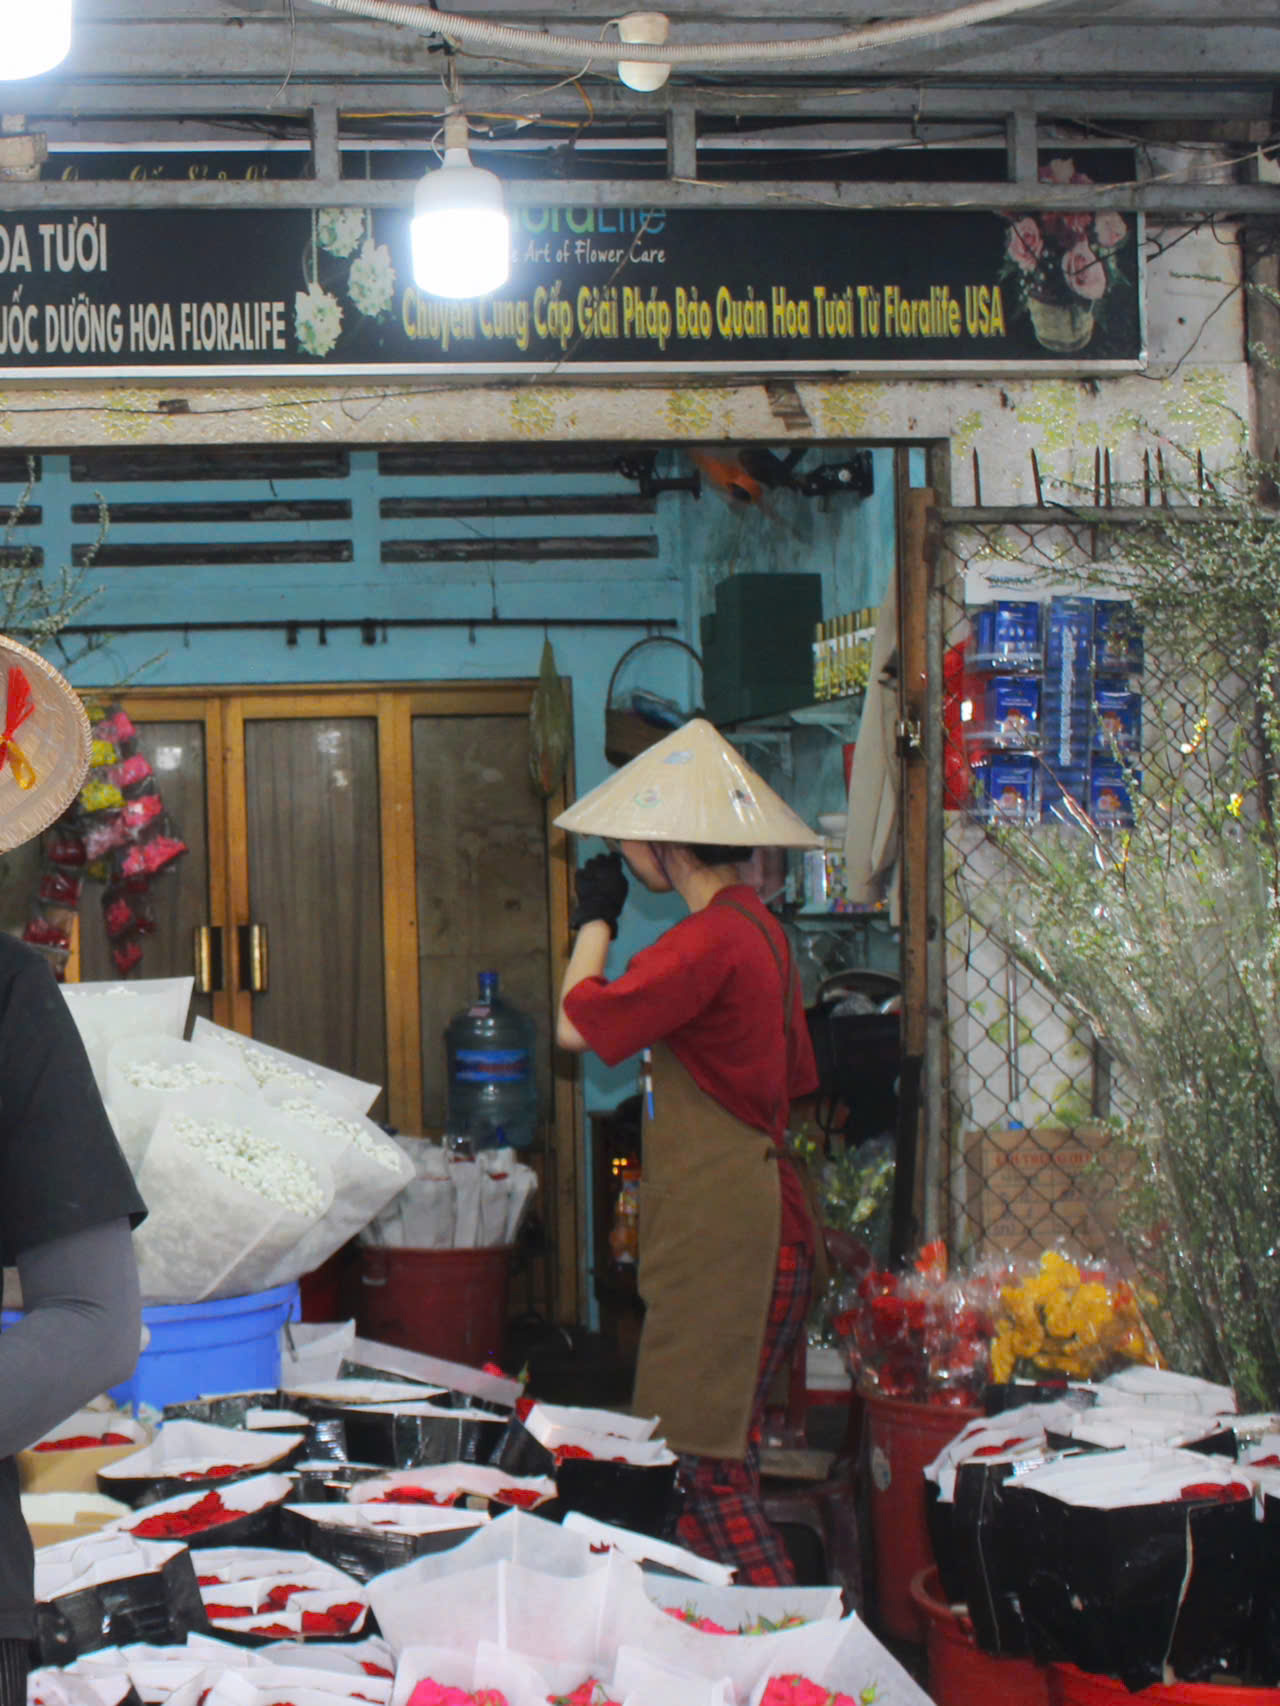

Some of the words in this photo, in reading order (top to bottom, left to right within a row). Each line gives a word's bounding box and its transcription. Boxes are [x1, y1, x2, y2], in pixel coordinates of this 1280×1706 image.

[38, 216, 107, 272] TƯƠI
[525, 240, 552, 264] Art
[555, 240, 570, 264] of
[574, 238, 625, 265] Flower
[629, 239, 667, 265] Care
[45, 292, 123, 354] DƯỠNG
[129, 303, 175, 352] HOA
[180, 302, 286, 352] FLORALIFE
[623, 286, 672, 351] Pháp
[772, 286, 811, 338] Hoa
[884, 285, 961, 338] Floralife
[965, 285, 1006, 338] USA
